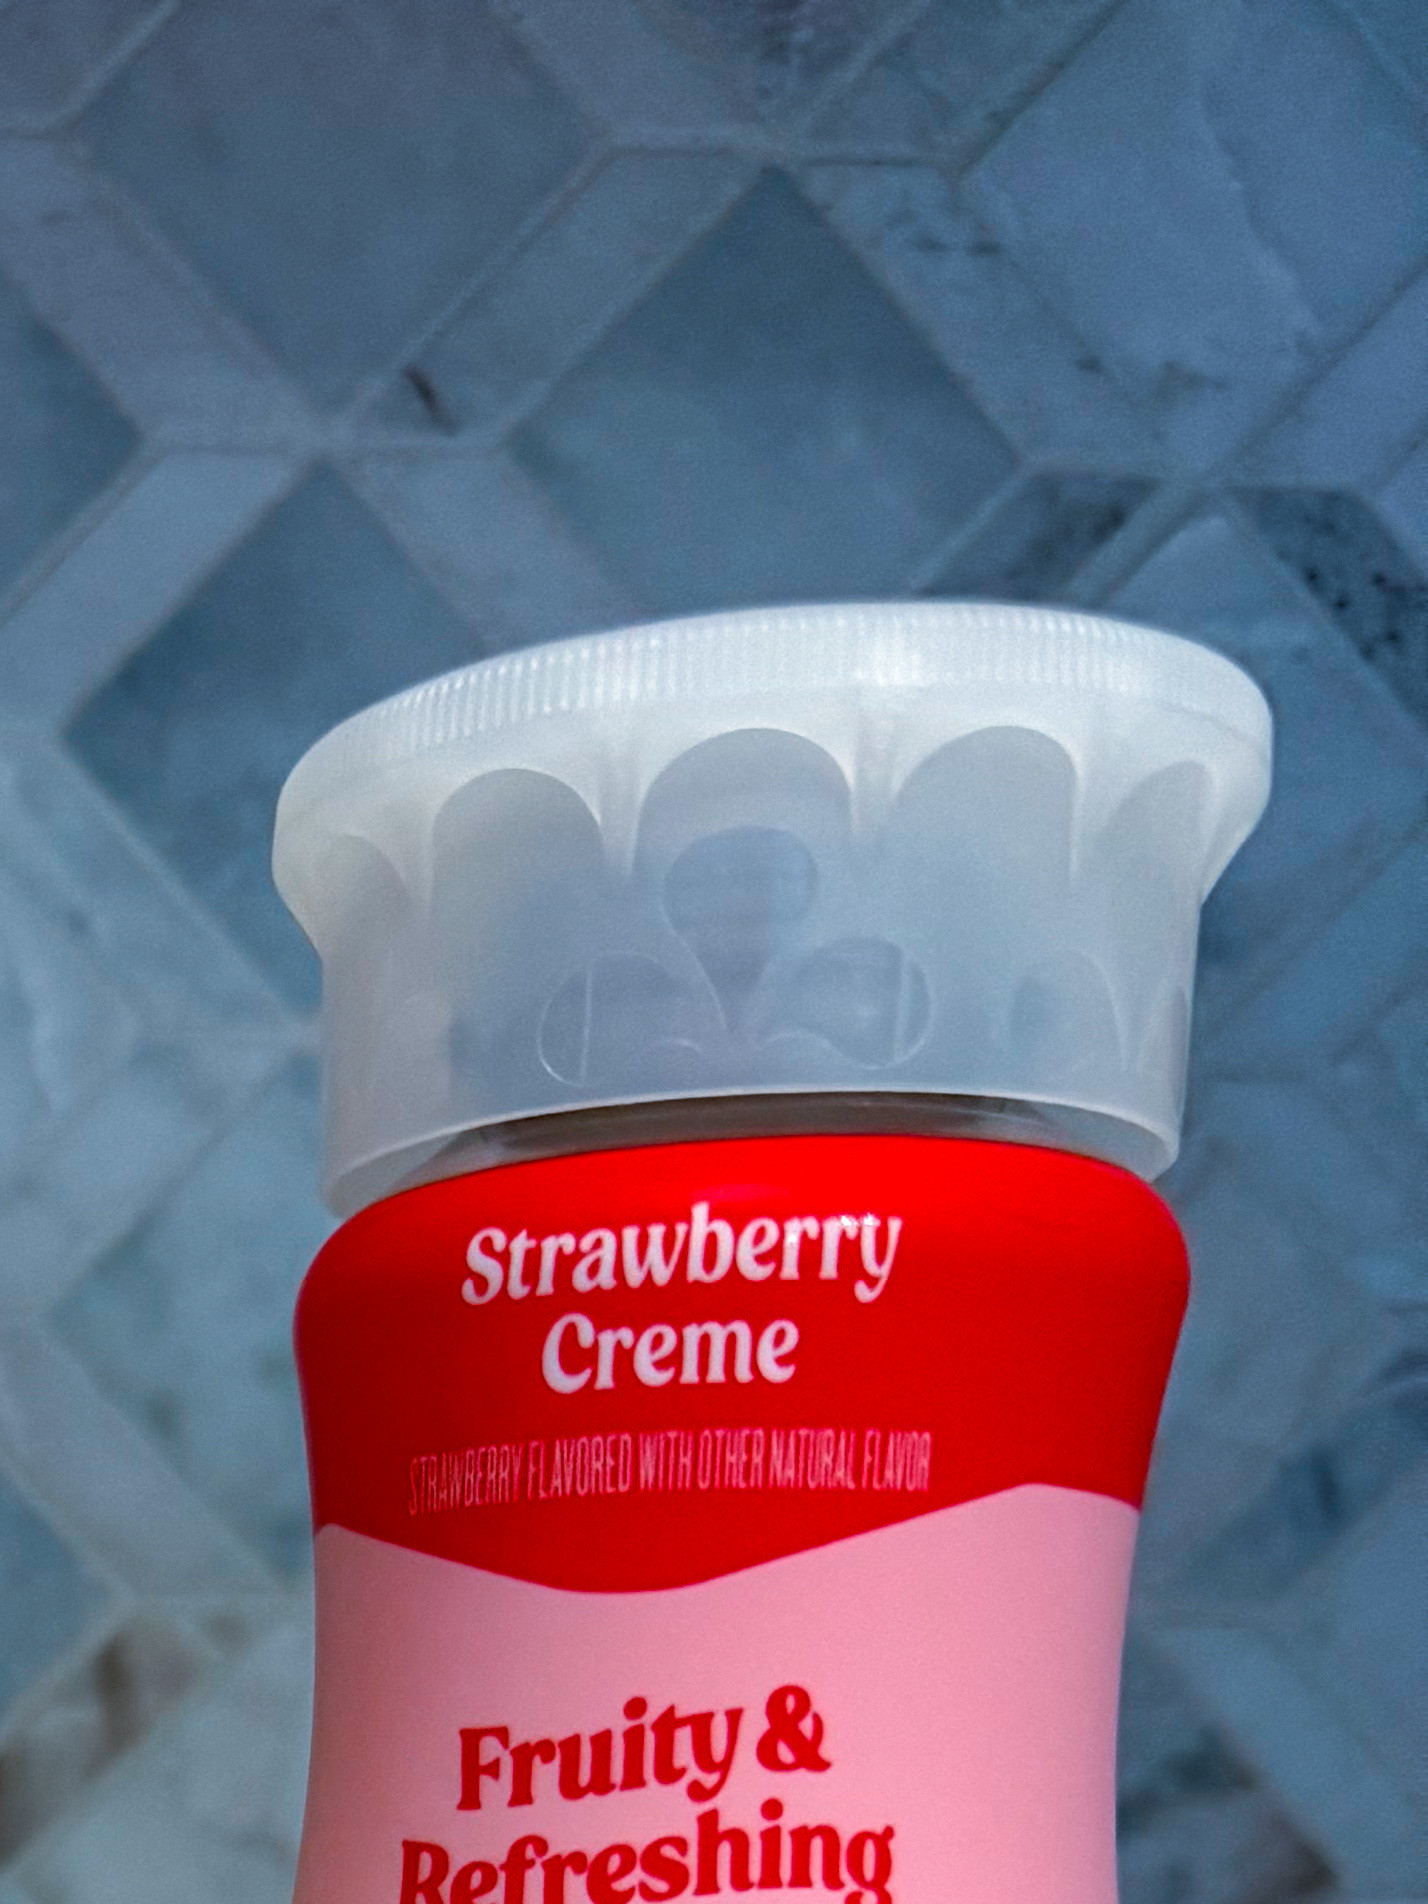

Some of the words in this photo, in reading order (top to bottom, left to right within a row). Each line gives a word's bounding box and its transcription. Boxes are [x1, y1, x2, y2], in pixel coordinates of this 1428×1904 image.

[461, 1200, 903, 1307] Strawberry
[540, 1310, 800, 1394] Creme
[409, 1443, 523, 1517] STRAWBERRY
[527, 1431, 632, 1500] FLAVORED
[638, 1430, 692, 1491] WITH
[697, 1426, 765, 1491] OTHER
[768, 1427, 856, 1491] NATURAL
[861, 1427, 932, 1492] FLAVOR
[456, 1696, 743, 1811] Fruity
[756, 1683, 832, 1773] &
